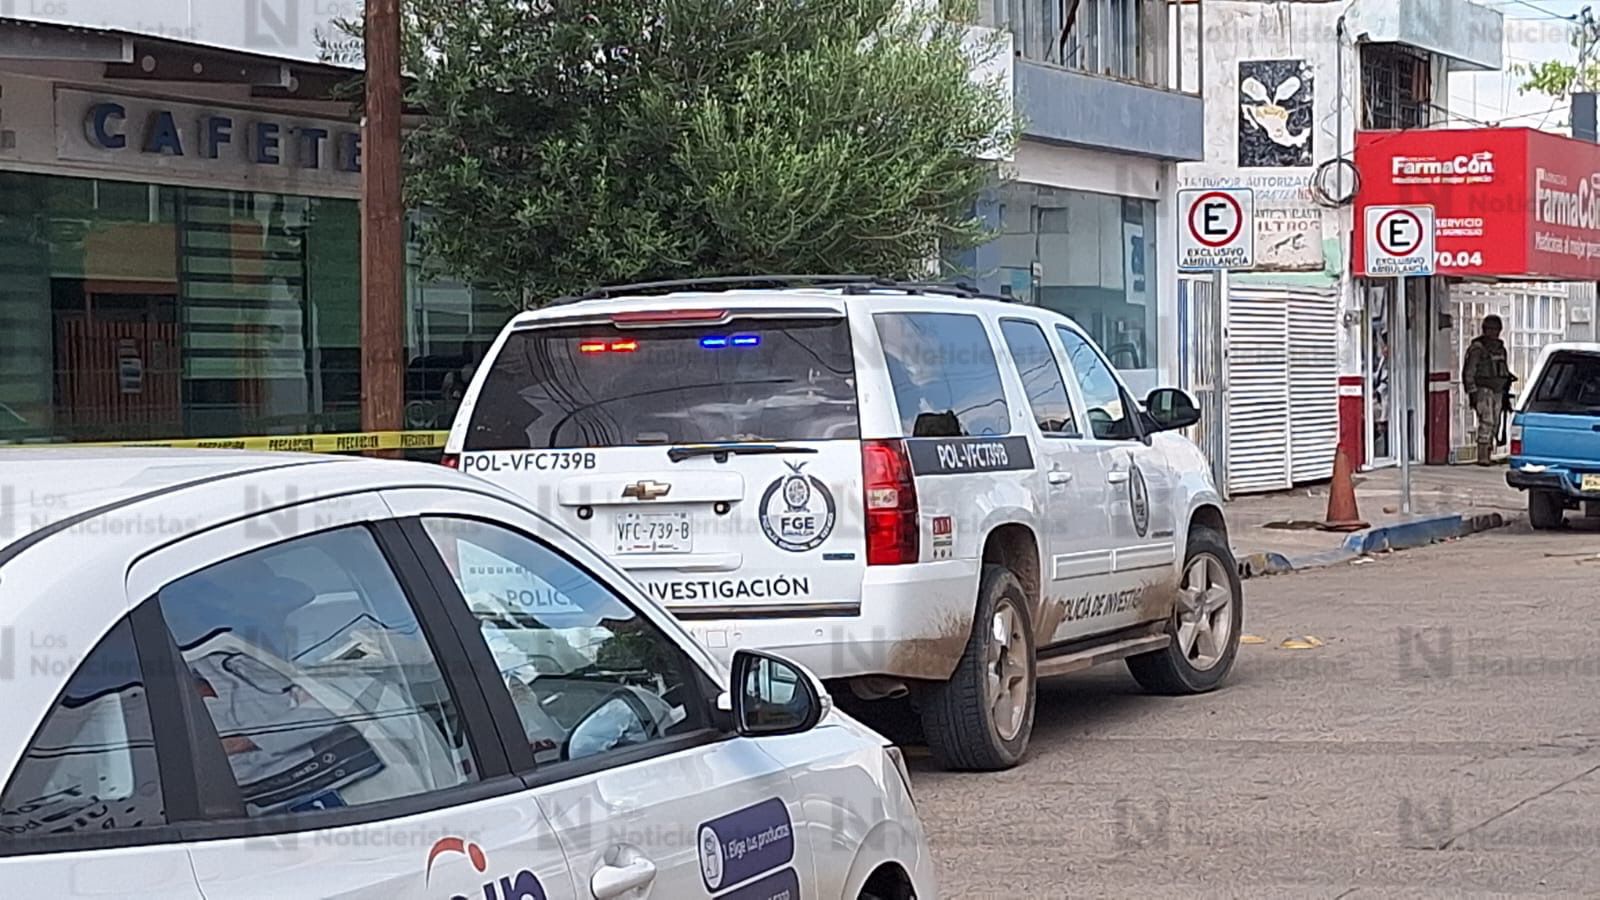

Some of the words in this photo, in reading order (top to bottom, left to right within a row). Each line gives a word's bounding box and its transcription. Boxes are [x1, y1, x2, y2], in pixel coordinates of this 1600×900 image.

[1204, 202, 1228, 235] E
[1389, 219, 1410, 247] E
[1187, 247, 1245, 257] EXCLUSIVO
[463, 452, 597, 472] POL-VFC739B
[617, 521, 689, 541] VFC-739-B
[781, 516, 815, 530] FGE
